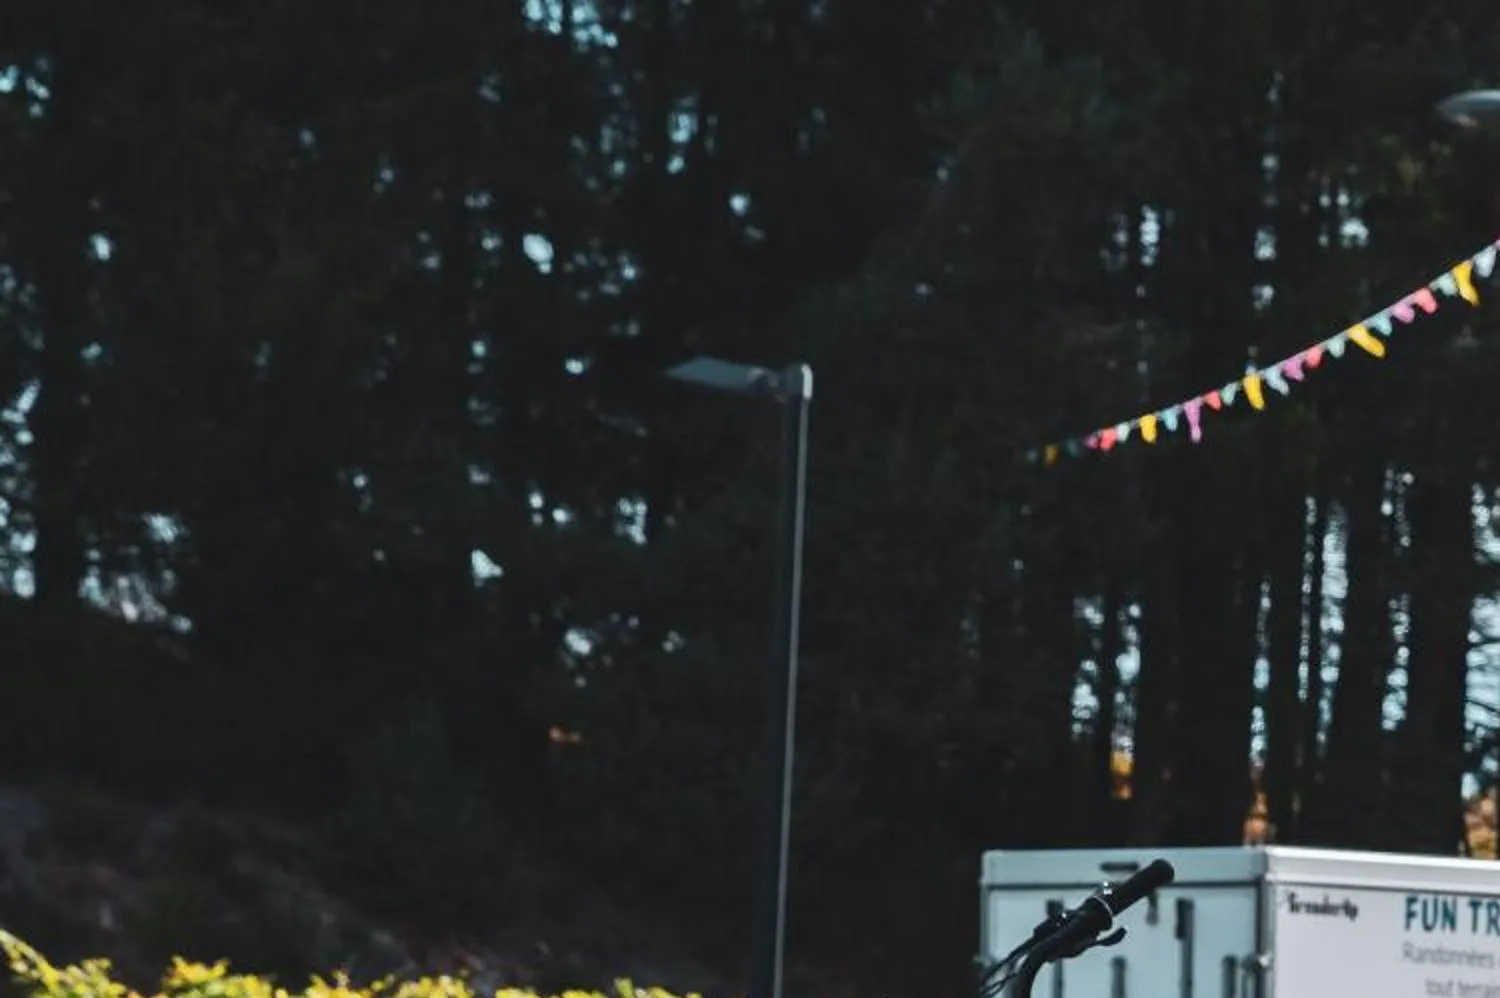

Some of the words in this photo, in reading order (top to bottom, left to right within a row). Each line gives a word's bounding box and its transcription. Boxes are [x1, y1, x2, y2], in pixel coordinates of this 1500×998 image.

[1404, 895, 1458, 933] FUN
[1402, 941, 1495, 970] Randonnées
[1425, 977, 1454, 998] tout
